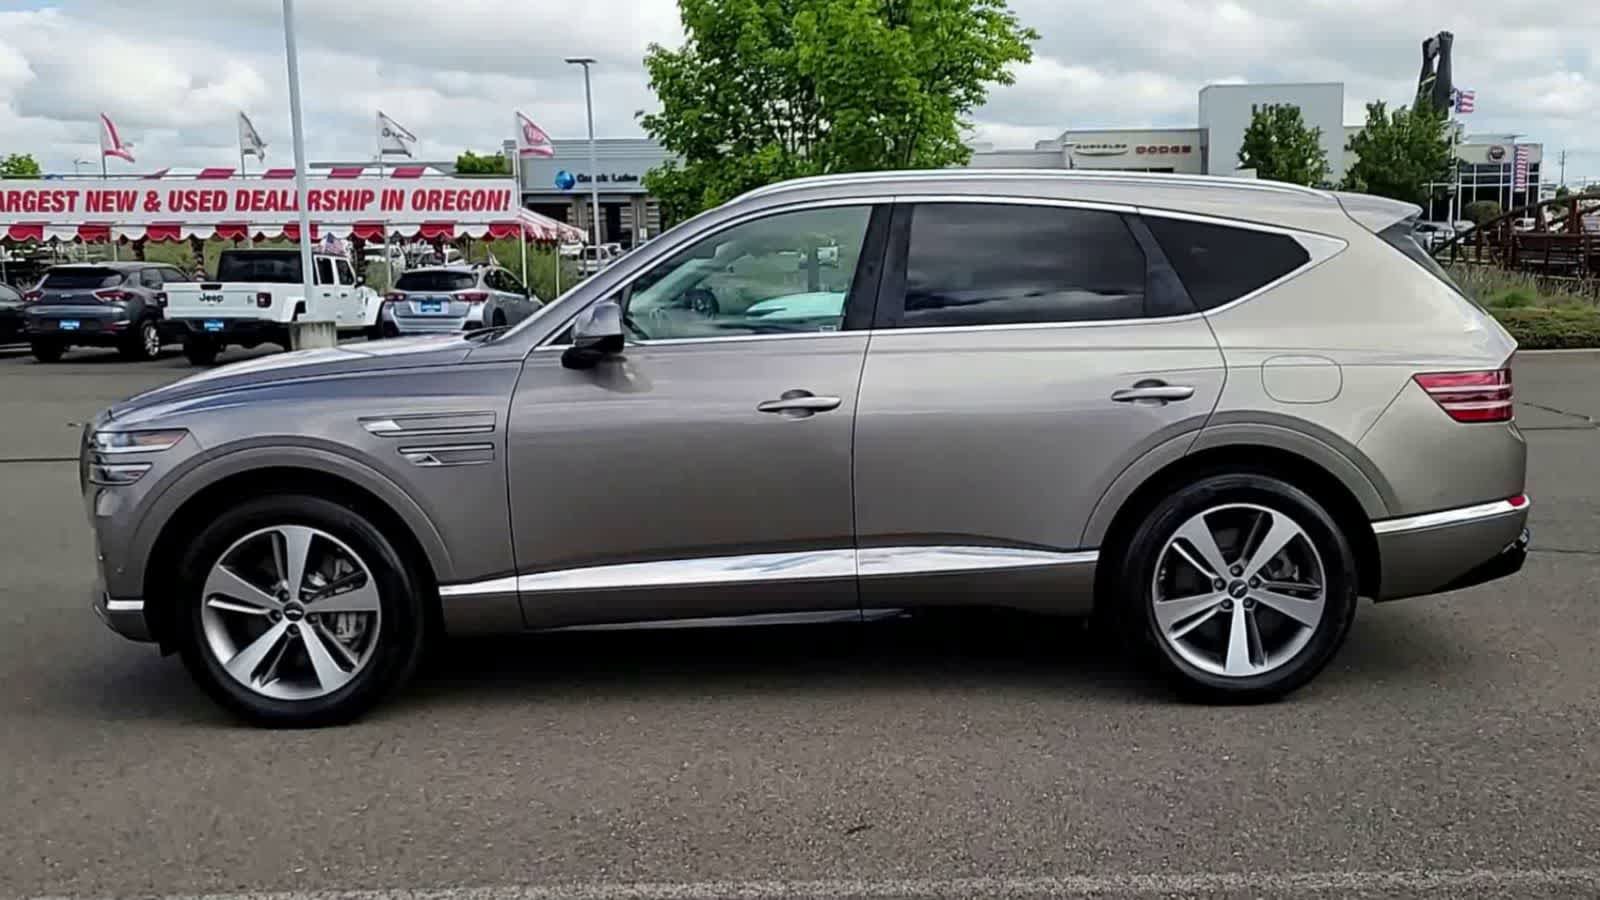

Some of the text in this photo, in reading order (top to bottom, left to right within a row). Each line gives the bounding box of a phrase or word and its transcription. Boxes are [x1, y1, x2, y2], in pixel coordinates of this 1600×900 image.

[85, 190, 138, 213] NEW
[144, 190, 161, 213] &
[168, 190, 228, 213] USED
[380, 189, 405, 212] IN
[411, 189, 511, 212] OREGON!
[199, 293, 224, 303] Jeep
